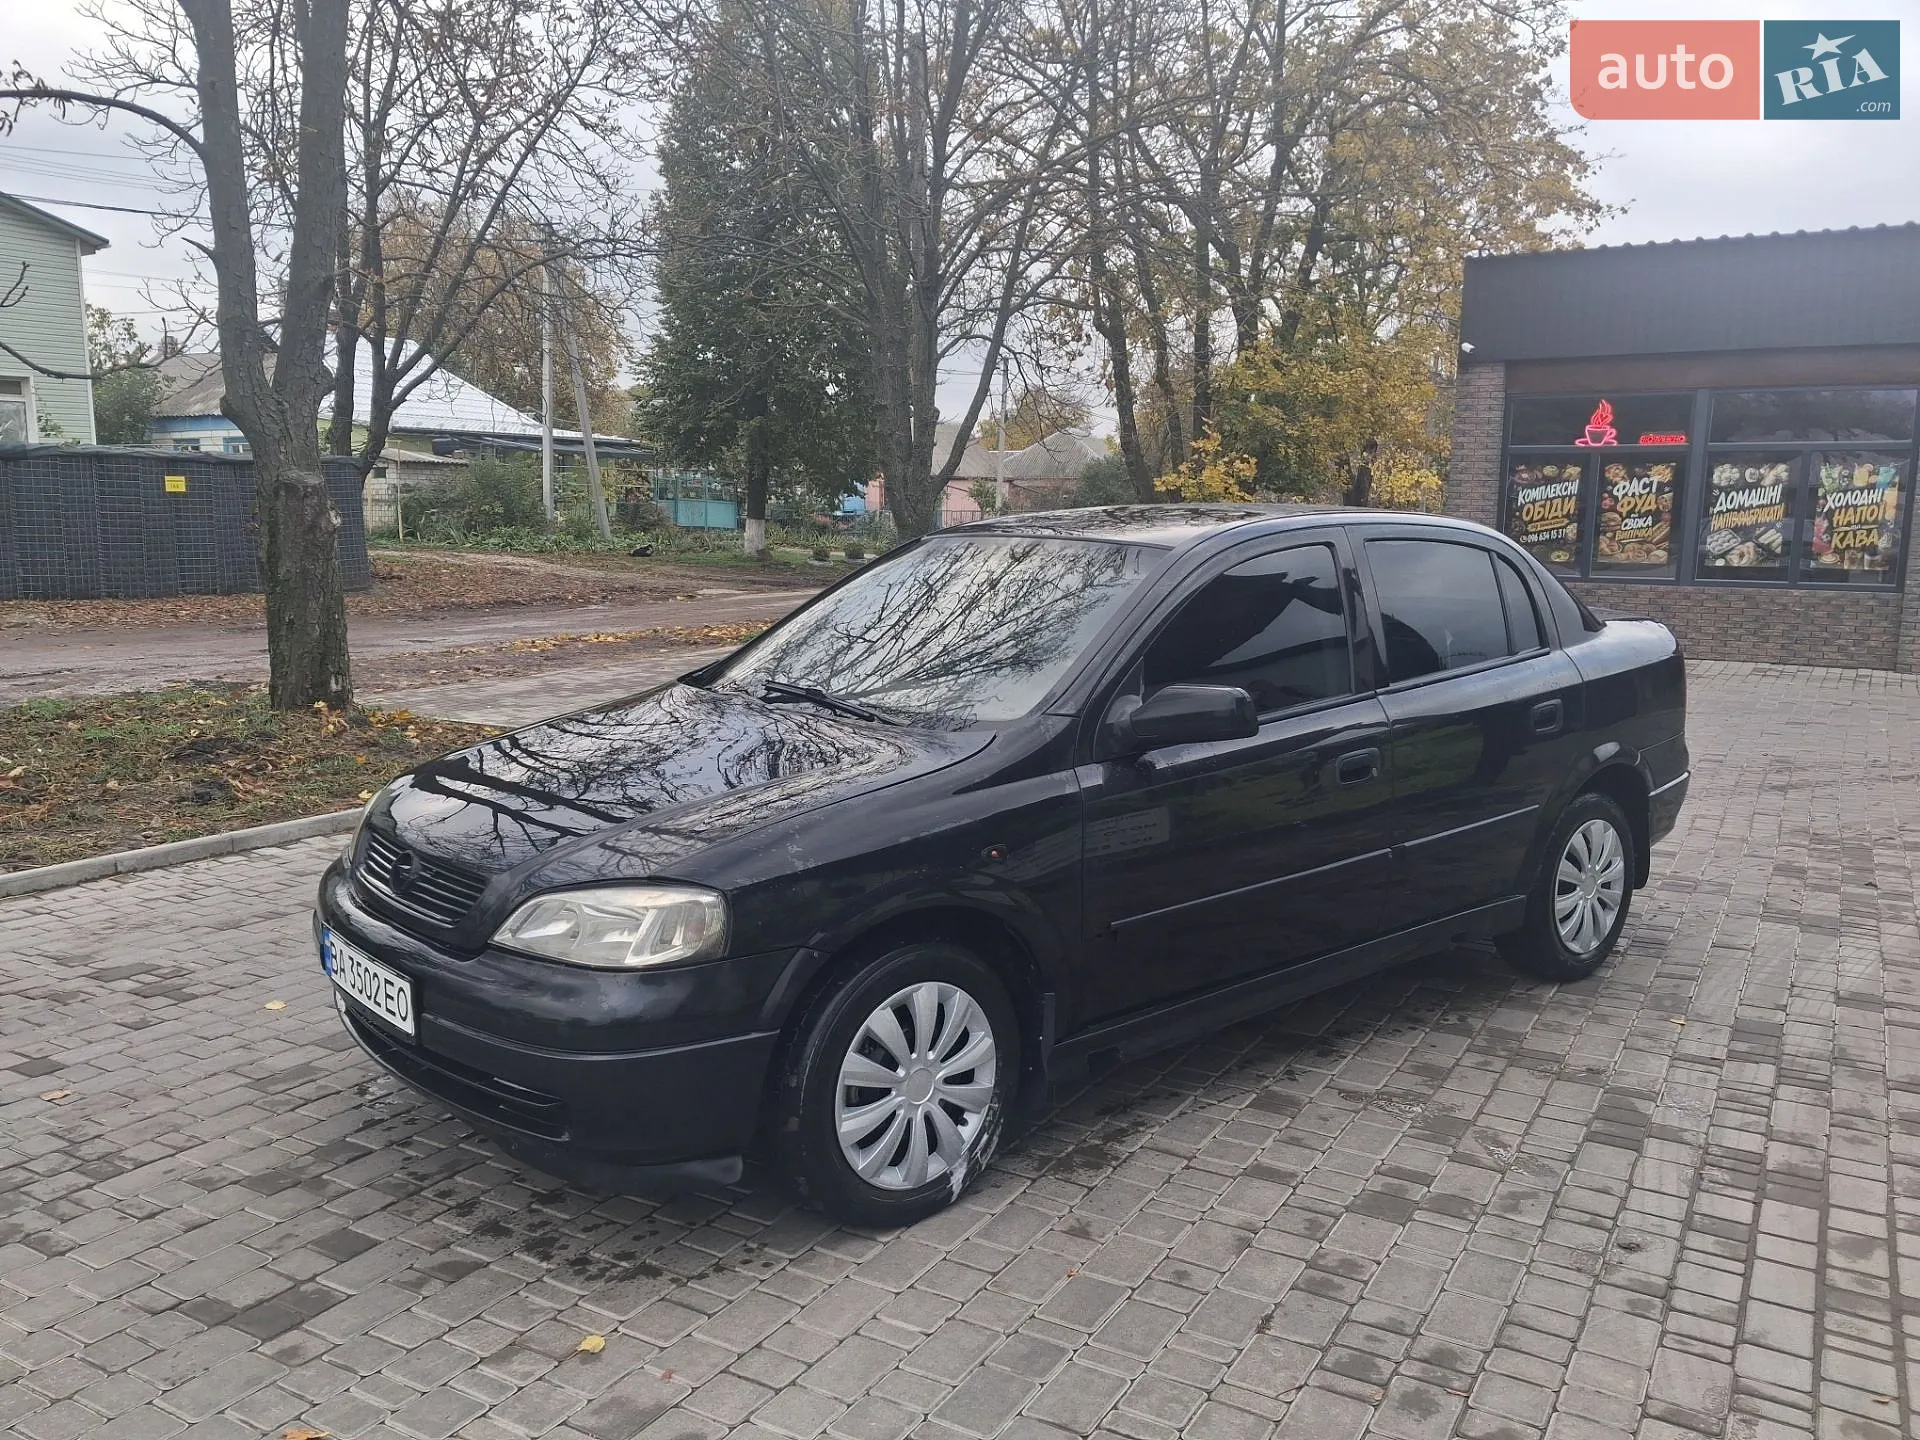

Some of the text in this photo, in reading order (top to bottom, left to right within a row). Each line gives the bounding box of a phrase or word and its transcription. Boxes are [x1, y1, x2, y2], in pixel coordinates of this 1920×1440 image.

[1517, 479, 1579, 506] КОМПЛЕКСНІ
[1613, 476, 1659, 500] ФАСТ
[1713, 483, 1783, 514] ДОМАШНІ
[1823, 488, 1883, 513] ХОЛОДНІ
[1522, 495, 1577, 521] ОБІДИ
[1616, 493, 1657, 517] ФУД
[1831, 528, 1880, 549] КАВА
[348, 954, 382, 1009] 3502
[384, 977, 409, 1022] EO
